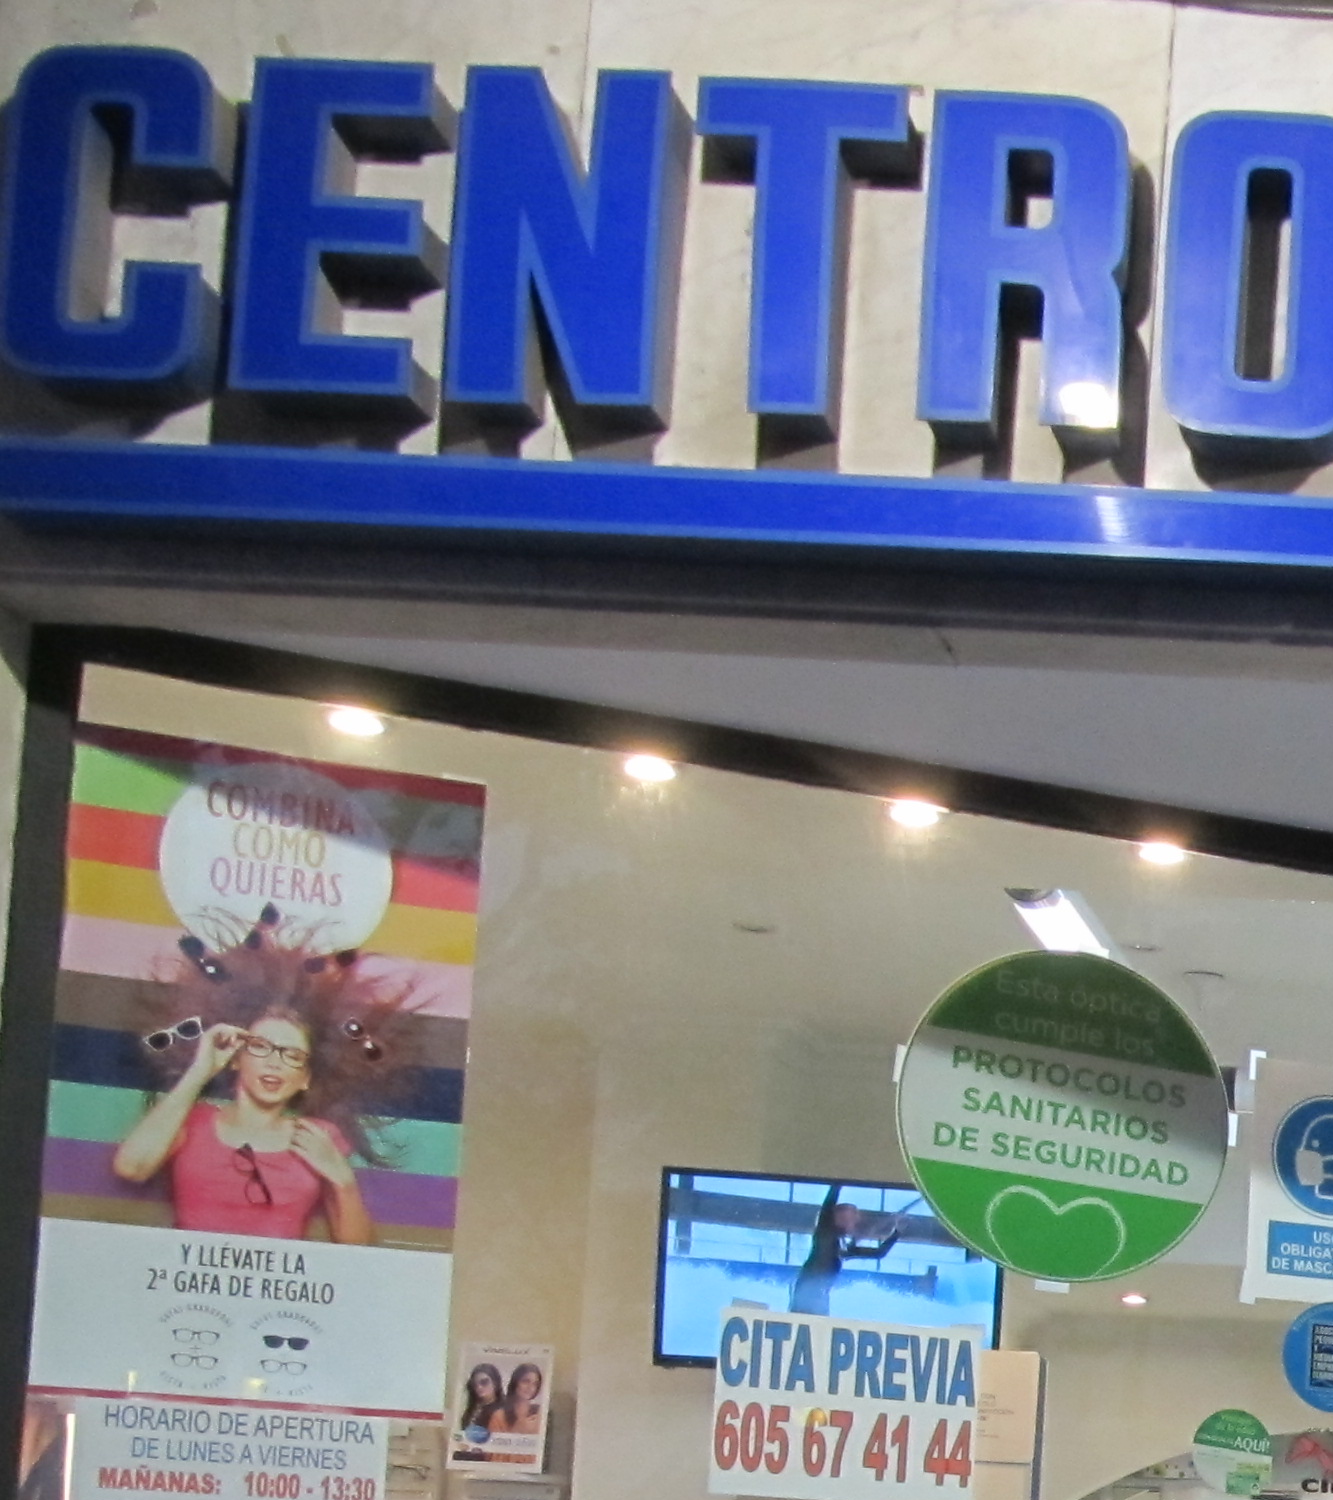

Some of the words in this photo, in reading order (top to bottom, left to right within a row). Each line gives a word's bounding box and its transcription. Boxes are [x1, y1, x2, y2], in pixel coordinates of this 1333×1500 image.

[207, 780, 354, 834] COMBINA
[233, 822, 326, 868] COMO
[210, 857, 343, 906] QUIERAS
[952, 1045, 1187, 1108] PROTOCOLOS
[961, 1086, 1169, 1145] SANITARIOS
[932, 1121, 980, 1151] DE
[990, 1132, 1189, 1186] SEGURIDAD
[1272, 1257, 1290, 1270] DE
[720, 1316, 815, 1393] CITA
[828, 1326, 976, 1407] PREVIA
[104, 1405, 211, 1434] HORARIO
[217, 1413, 248, 1437] DE
[253, 1416, 376, 1445] APERTURA
[714, 1399, 791, 1475] 605
[803, 1406, 853, 1478] 67
[862, 1412, 910, 1484] 41
[924, 1418, 972, 1489] 44
[131, 1436, 160, 1459] DE
[166, 1440, 234, 1464] LUNES
[238, 1444, 254, 1465] A
[258, 1445, 347, 1471] VIERNES
